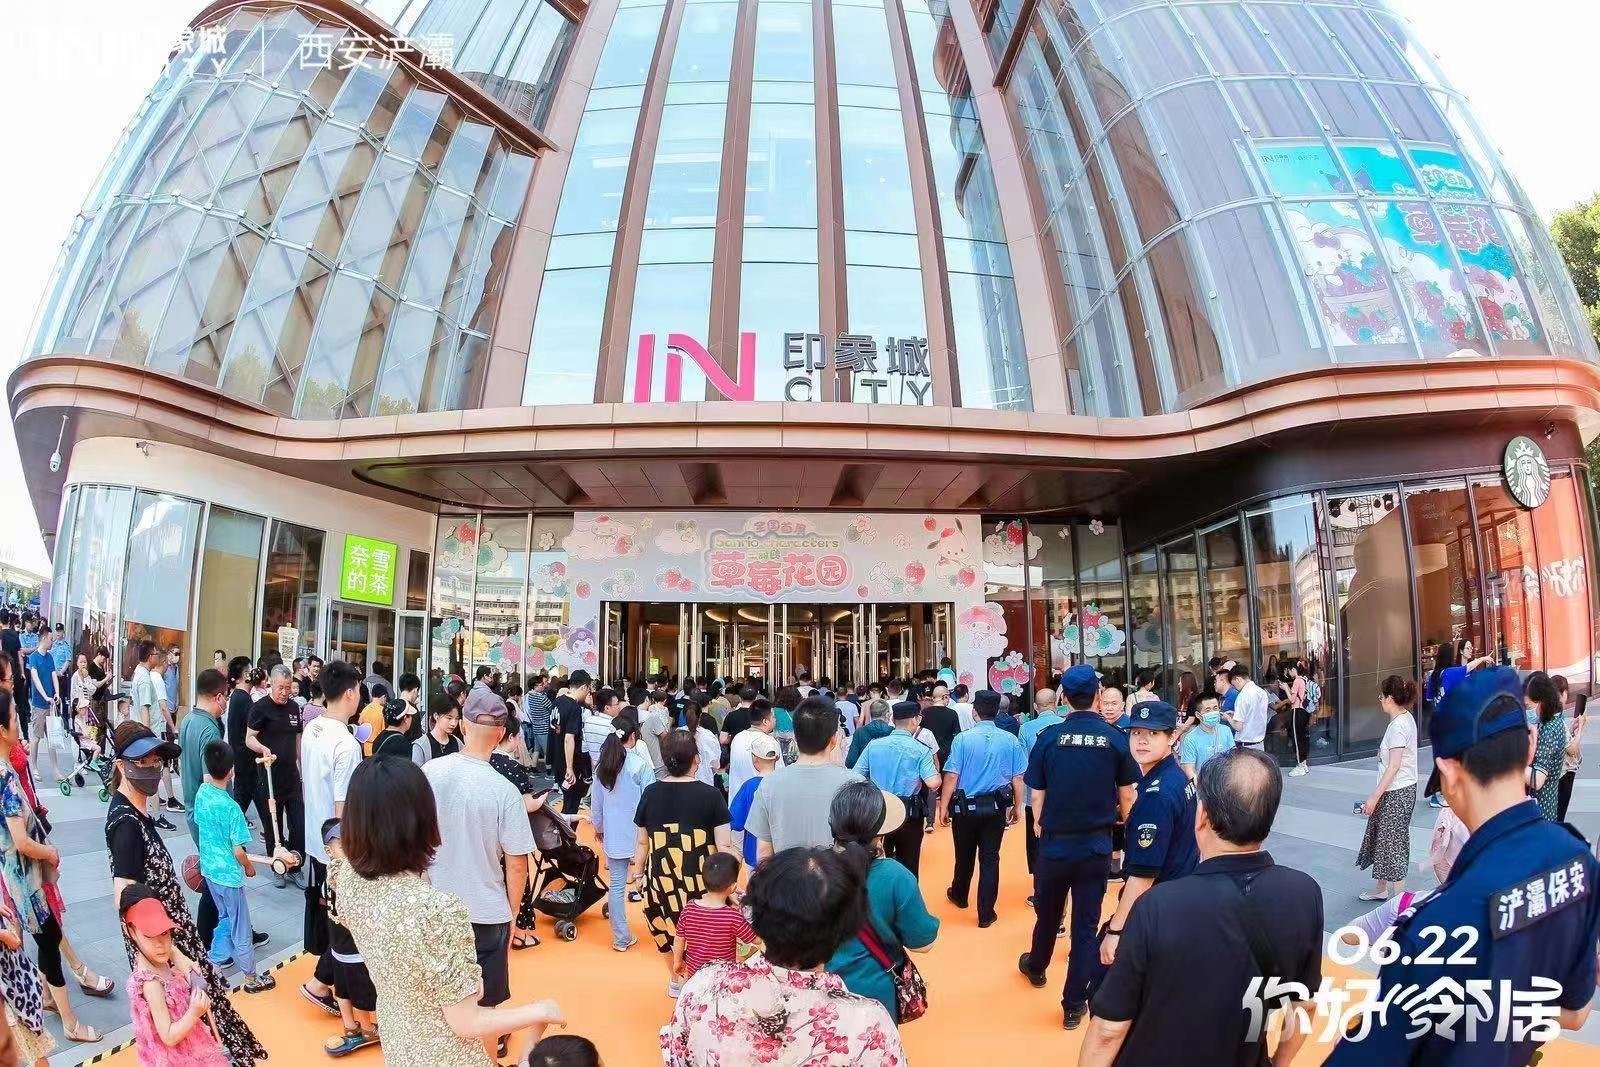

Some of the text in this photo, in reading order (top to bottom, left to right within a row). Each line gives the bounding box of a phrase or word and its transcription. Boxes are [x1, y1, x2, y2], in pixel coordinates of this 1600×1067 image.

[633, 331, 759, 402] IN
[783, 331, 930, 377] 印象城
[784, 376, 932, 405] CITY
[350, 545, 391, 572] 奈雪
[711, 551, 847, 595] 草莓花园
[347, 571, 389, 596] 的茶
[1059, 733, 1108, 747] 浐灞保安
[1498, 861, 1585, 931] 浐灞保安
